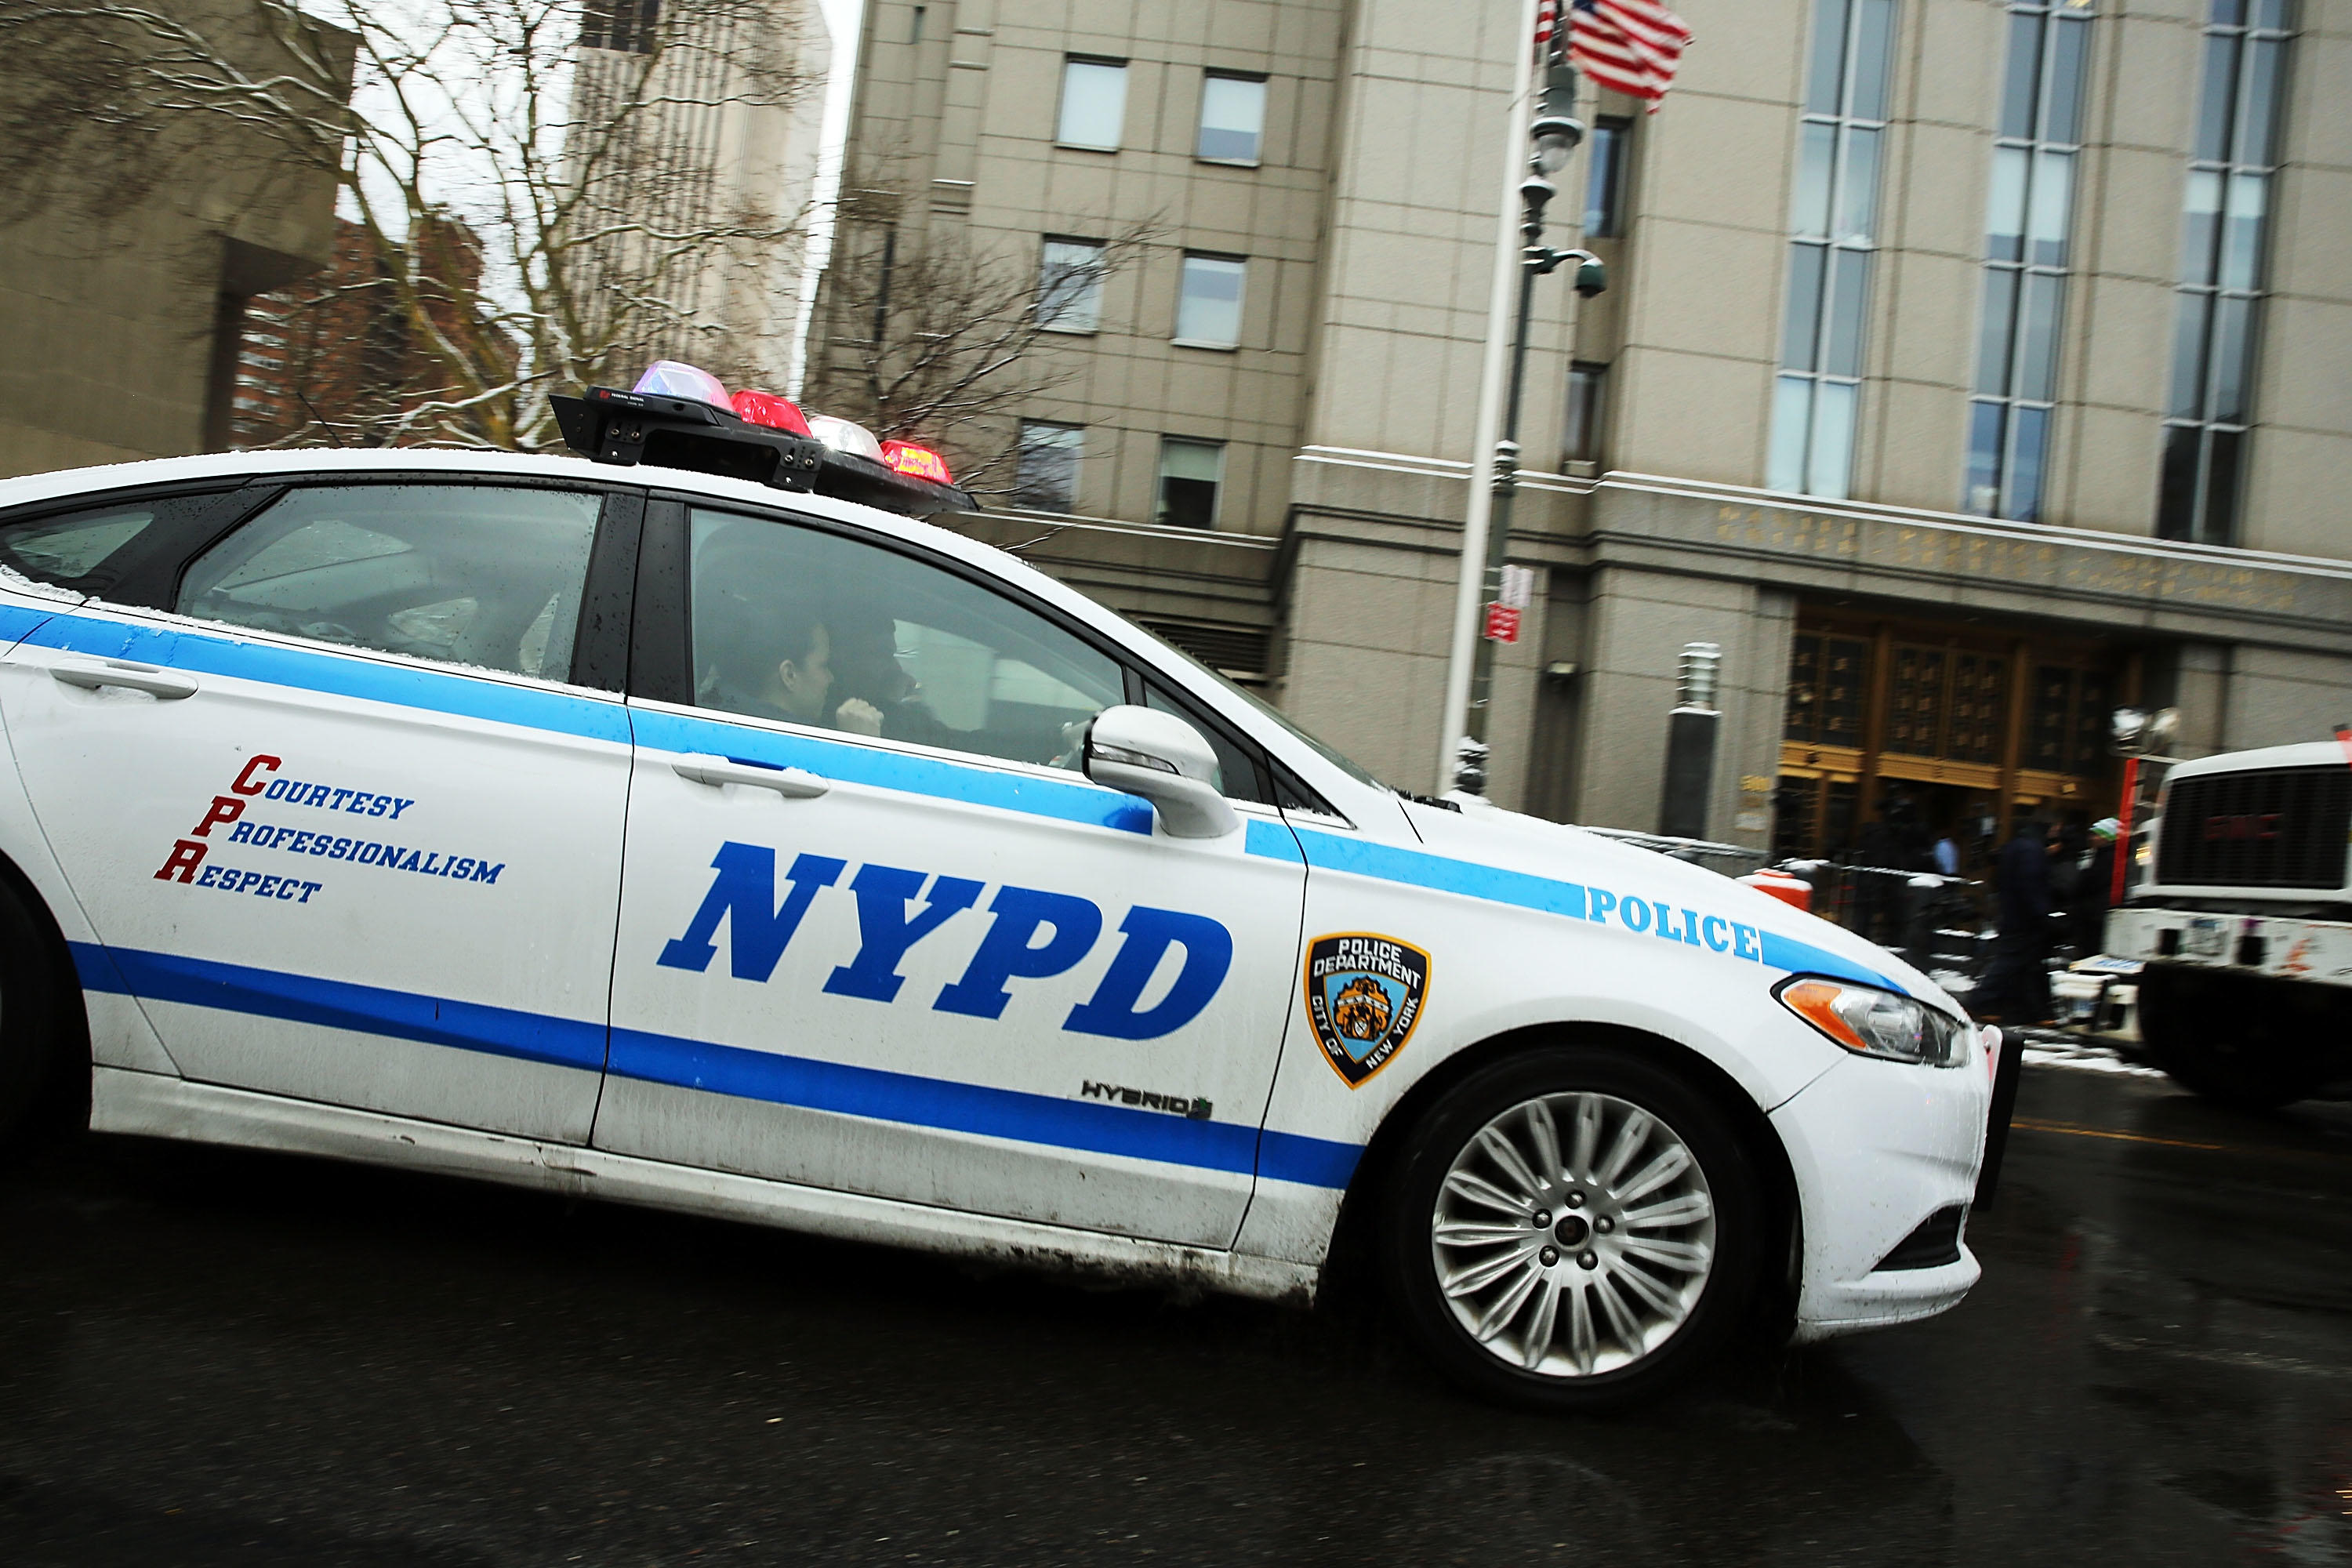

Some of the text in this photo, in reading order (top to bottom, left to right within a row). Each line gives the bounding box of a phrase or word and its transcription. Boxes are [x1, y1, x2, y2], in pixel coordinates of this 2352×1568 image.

[231, 754, 414, 819] COURTESY
[153, 839, 322, 903] RESPECT
[191, 795, 506, 884] PROFESSIONALISM
[655, 840, 1233, 1041] NYPD
[1338, 938, 1402, 964] POLICE
[1587, 887, 1759, 962] POLICE
[1313, 954, 1421, 989] DEPARTMENT
[1312, 995, 1344, 1056] CITY OF
[1366, 996, 1419, 1069] NEW YORK
[1081, 1080, 1189, 1113] HYBRID
